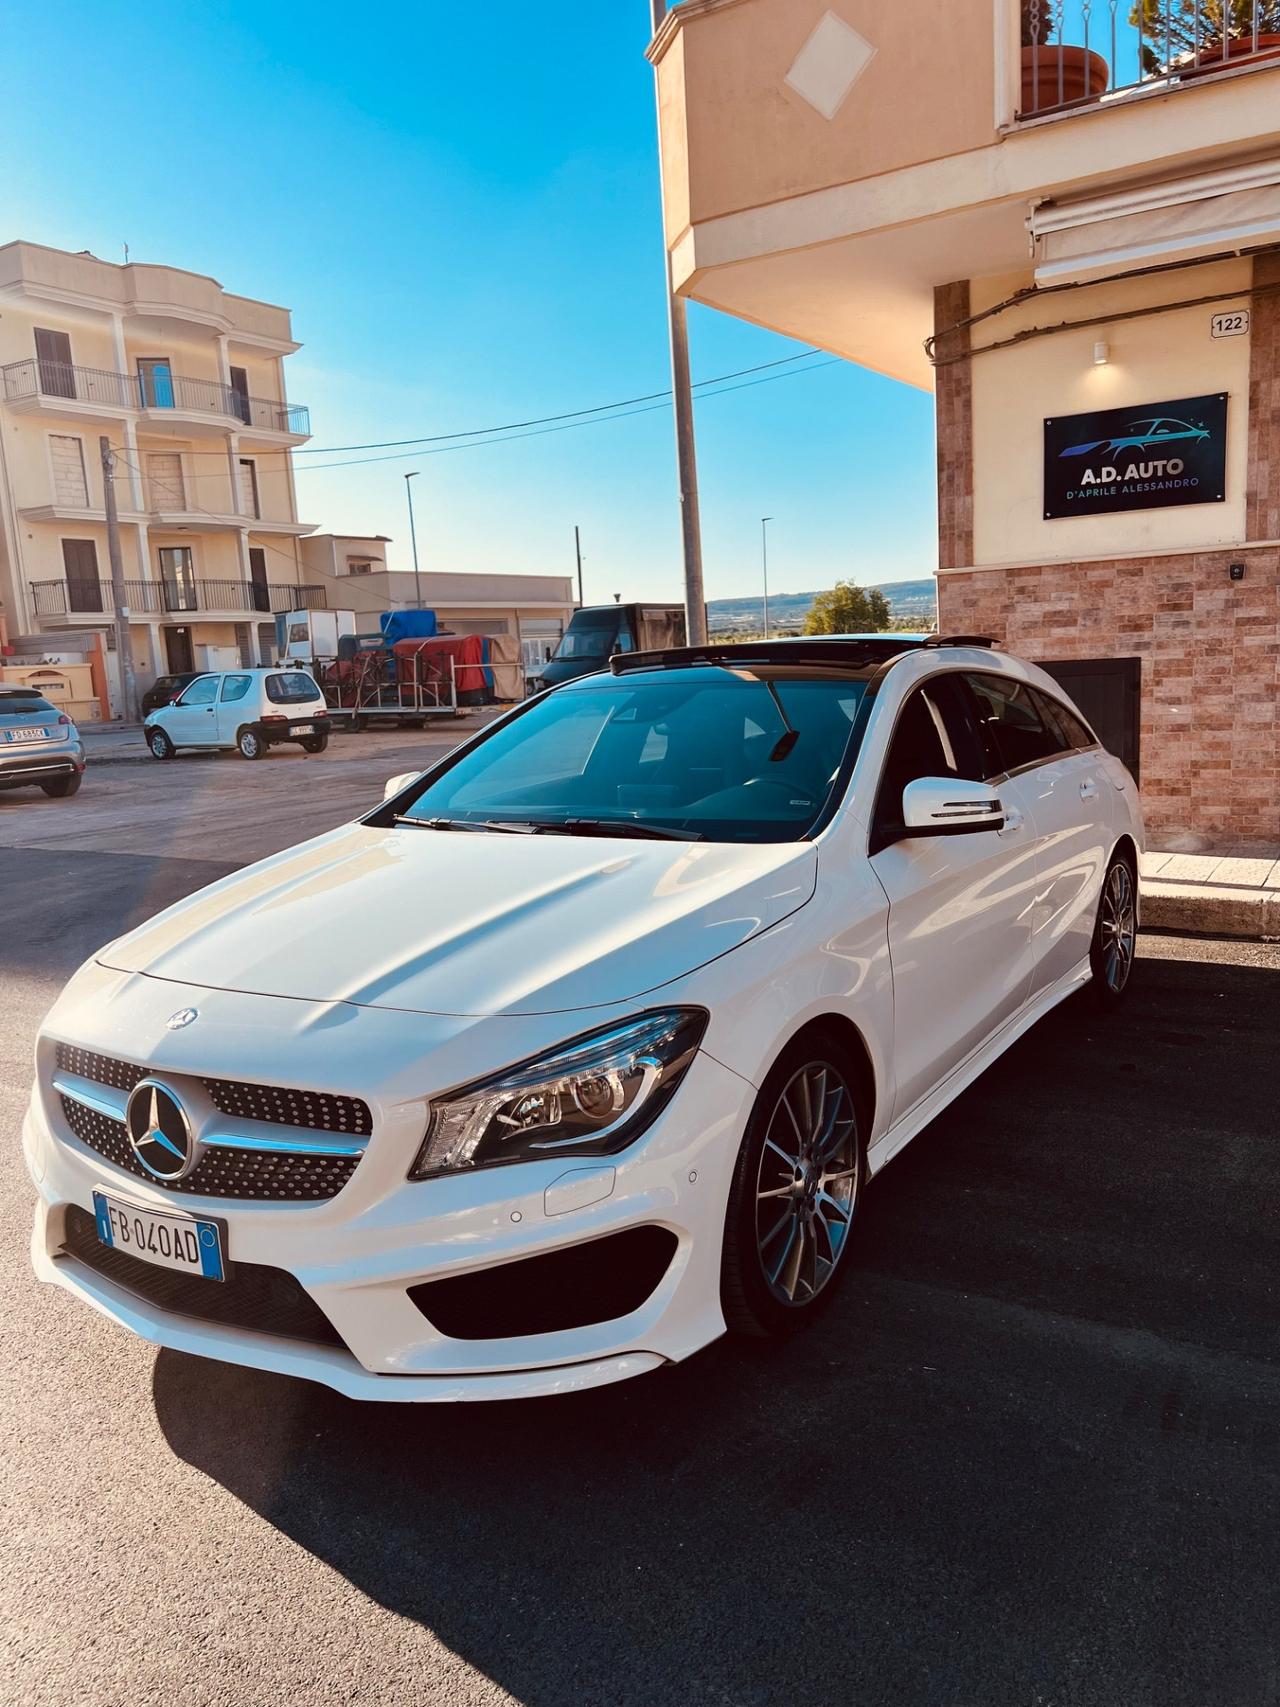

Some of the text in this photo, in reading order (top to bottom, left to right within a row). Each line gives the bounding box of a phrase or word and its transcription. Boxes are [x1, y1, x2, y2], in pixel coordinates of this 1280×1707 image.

[1216, 316, 1242, 332] 122
[1066, 477, 1199, 500] D'APRILE ALESSANDRO
[108, 1206, 199, 1264] FB 040AD
